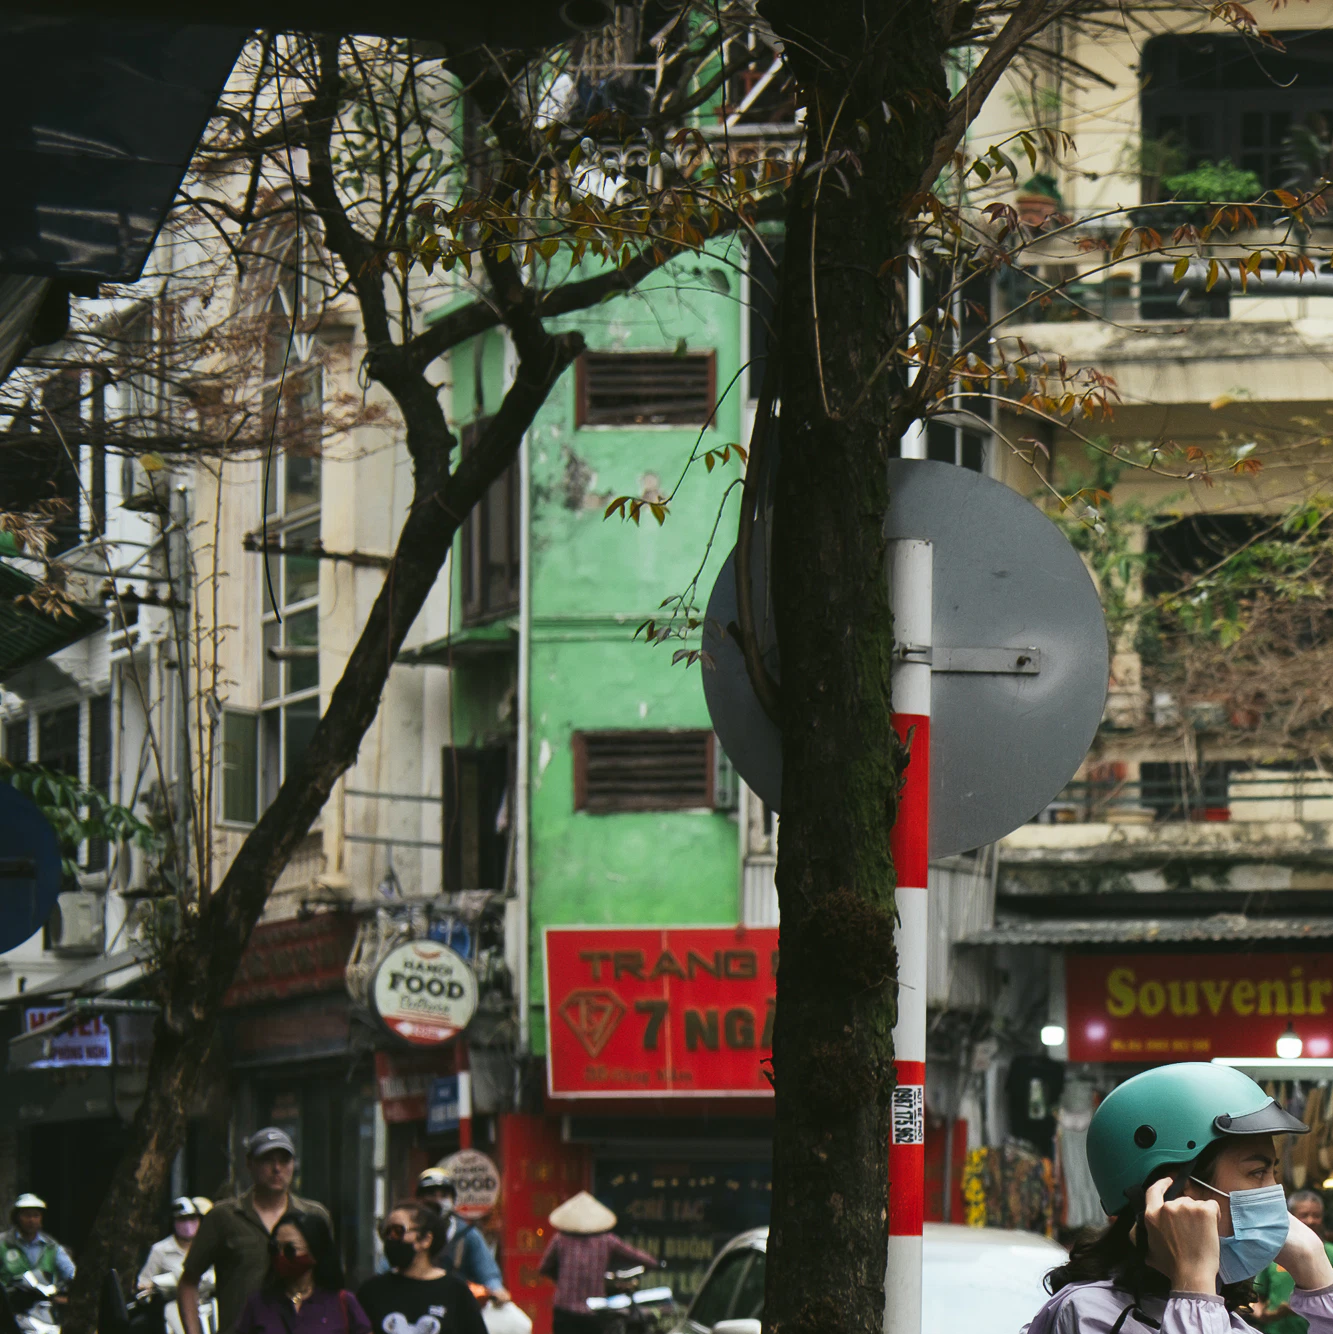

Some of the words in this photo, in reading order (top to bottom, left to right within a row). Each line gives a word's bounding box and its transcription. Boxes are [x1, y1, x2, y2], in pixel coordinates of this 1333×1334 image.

[388, 971, 464, 1001] FOOD
[579, 950, 758, 982] TRANG
[1106, 966, 1333, 1018] Souvenir
[634, 1000, 670, 1051] 7
